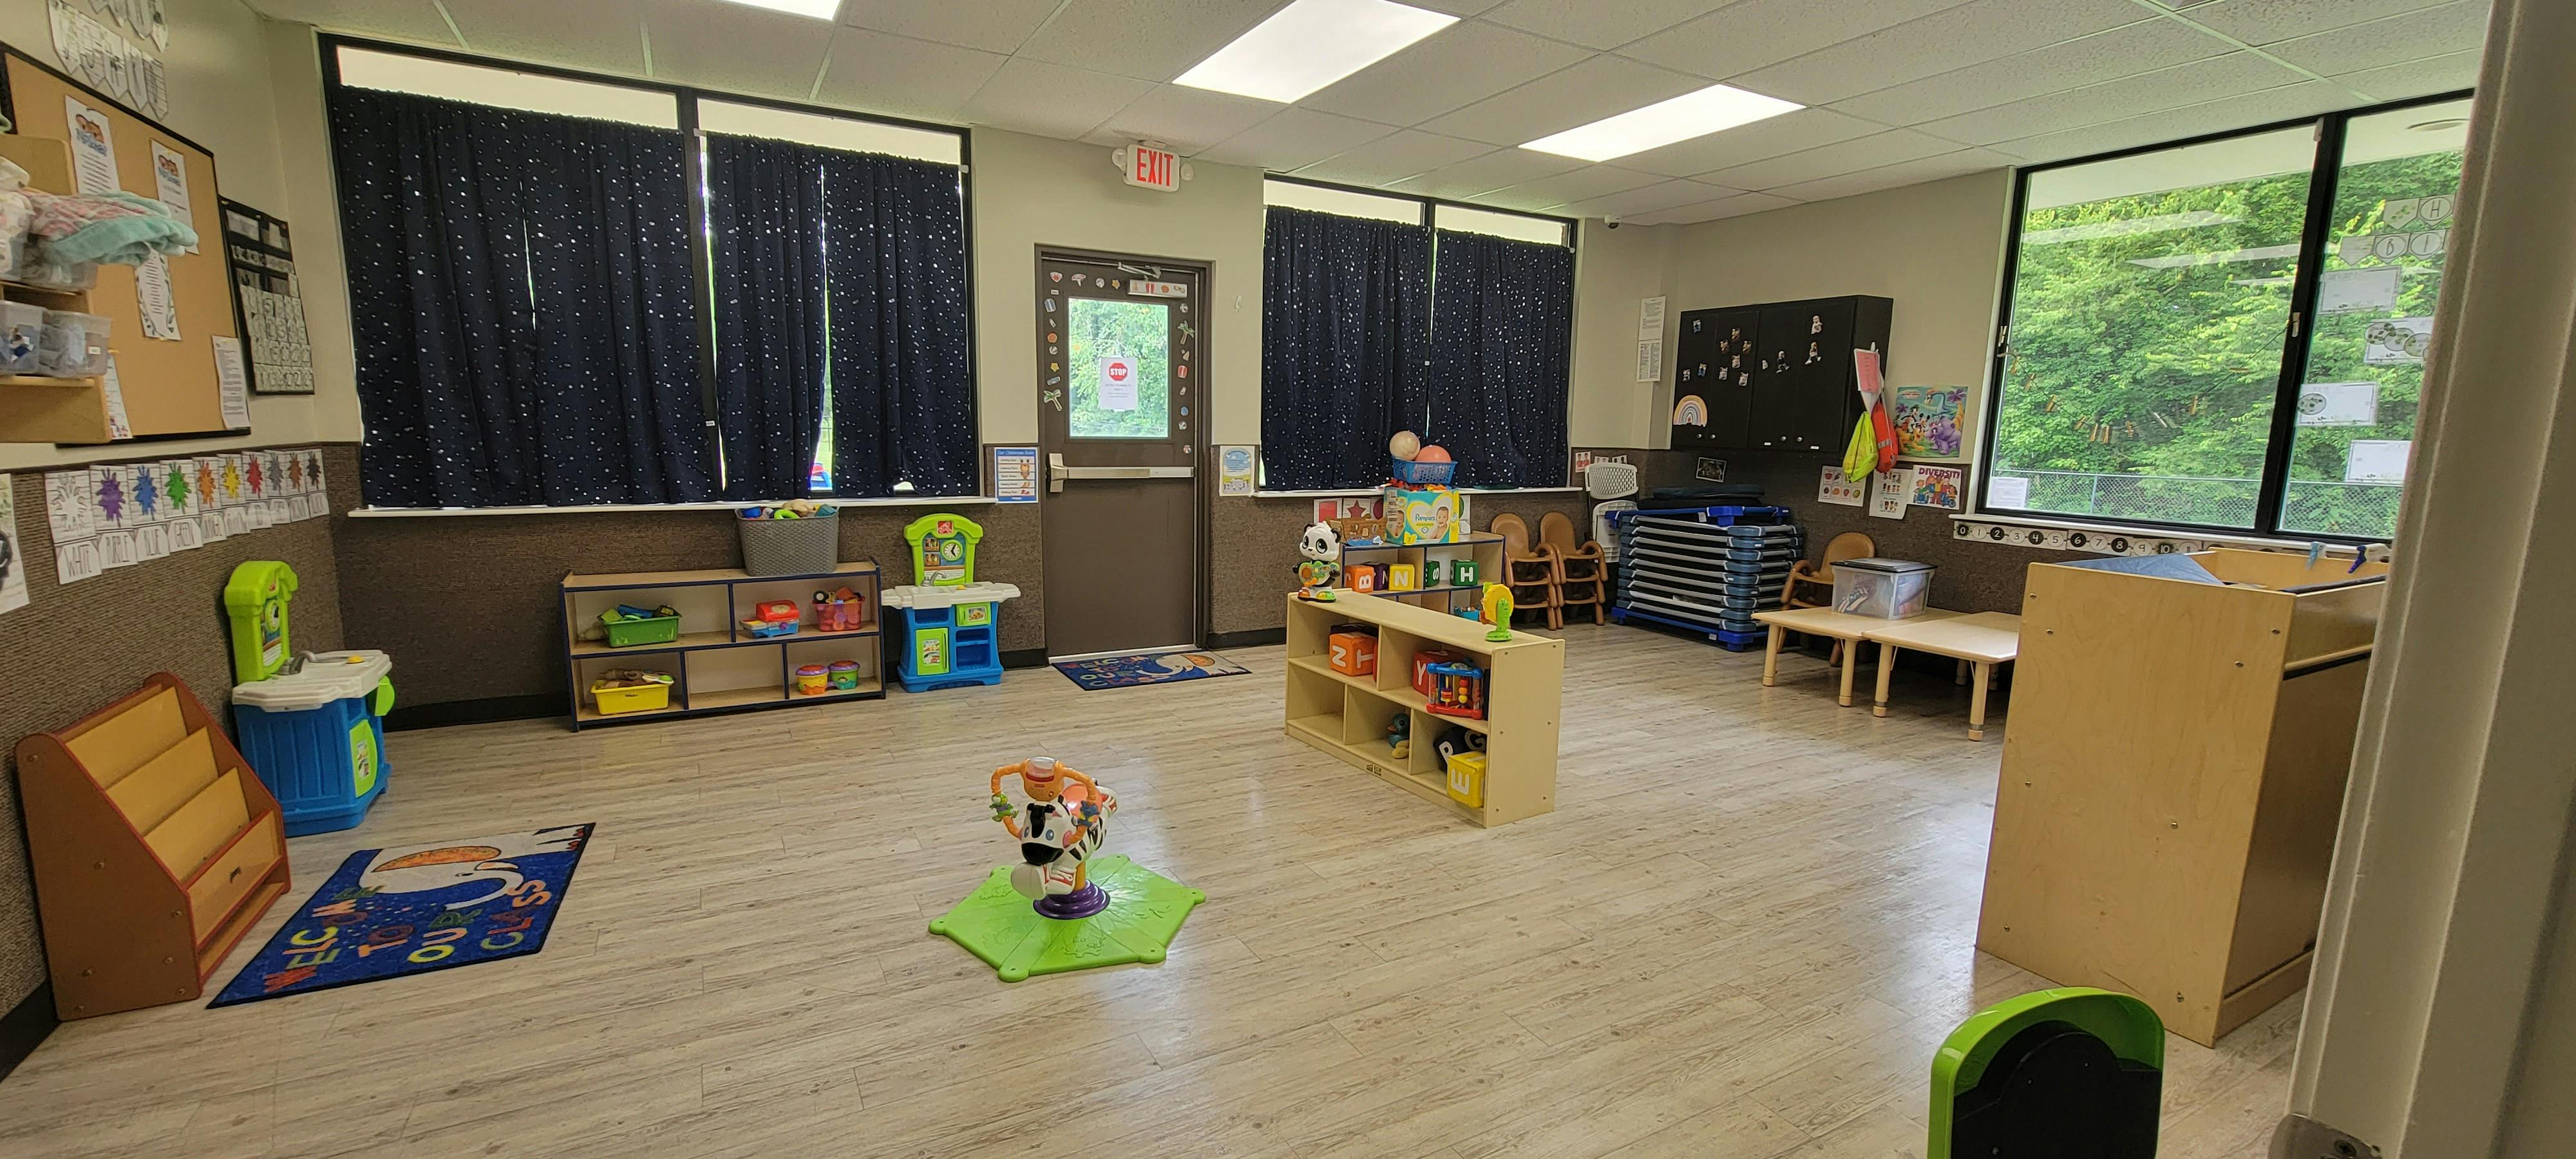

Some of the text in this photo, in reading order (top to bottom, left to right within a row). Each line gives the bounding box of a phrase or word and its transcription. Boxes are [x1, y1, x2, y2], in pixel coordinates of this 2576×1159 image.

[1137, 147, 1173, 187] EXIT
[1110, 368, 1127, 377] STOP
[1415, 513, 1435, 522] Pampers
[2032, 534, 2039, 542] 4
[2074, 536, 2080, 544] 6
[2116, 540, 2123, 549] 8
[2139, 544, 2146, 552] 9
[2160, 545, 2170, 554] 10
[64, 543, 92, 578] WHITE
[1359, 575, 1371, 589] B
[1394, 570, 1408, 587] N
[1432, 567, 1439, 580] S
[1460, 567, 1474, 583] H
[480, 878, 553, 951] CLASS
[263, 885, 381, 993] WELCOME
[357, 924, 416, 958] TO
[406, 908, 484, 964] OUR
